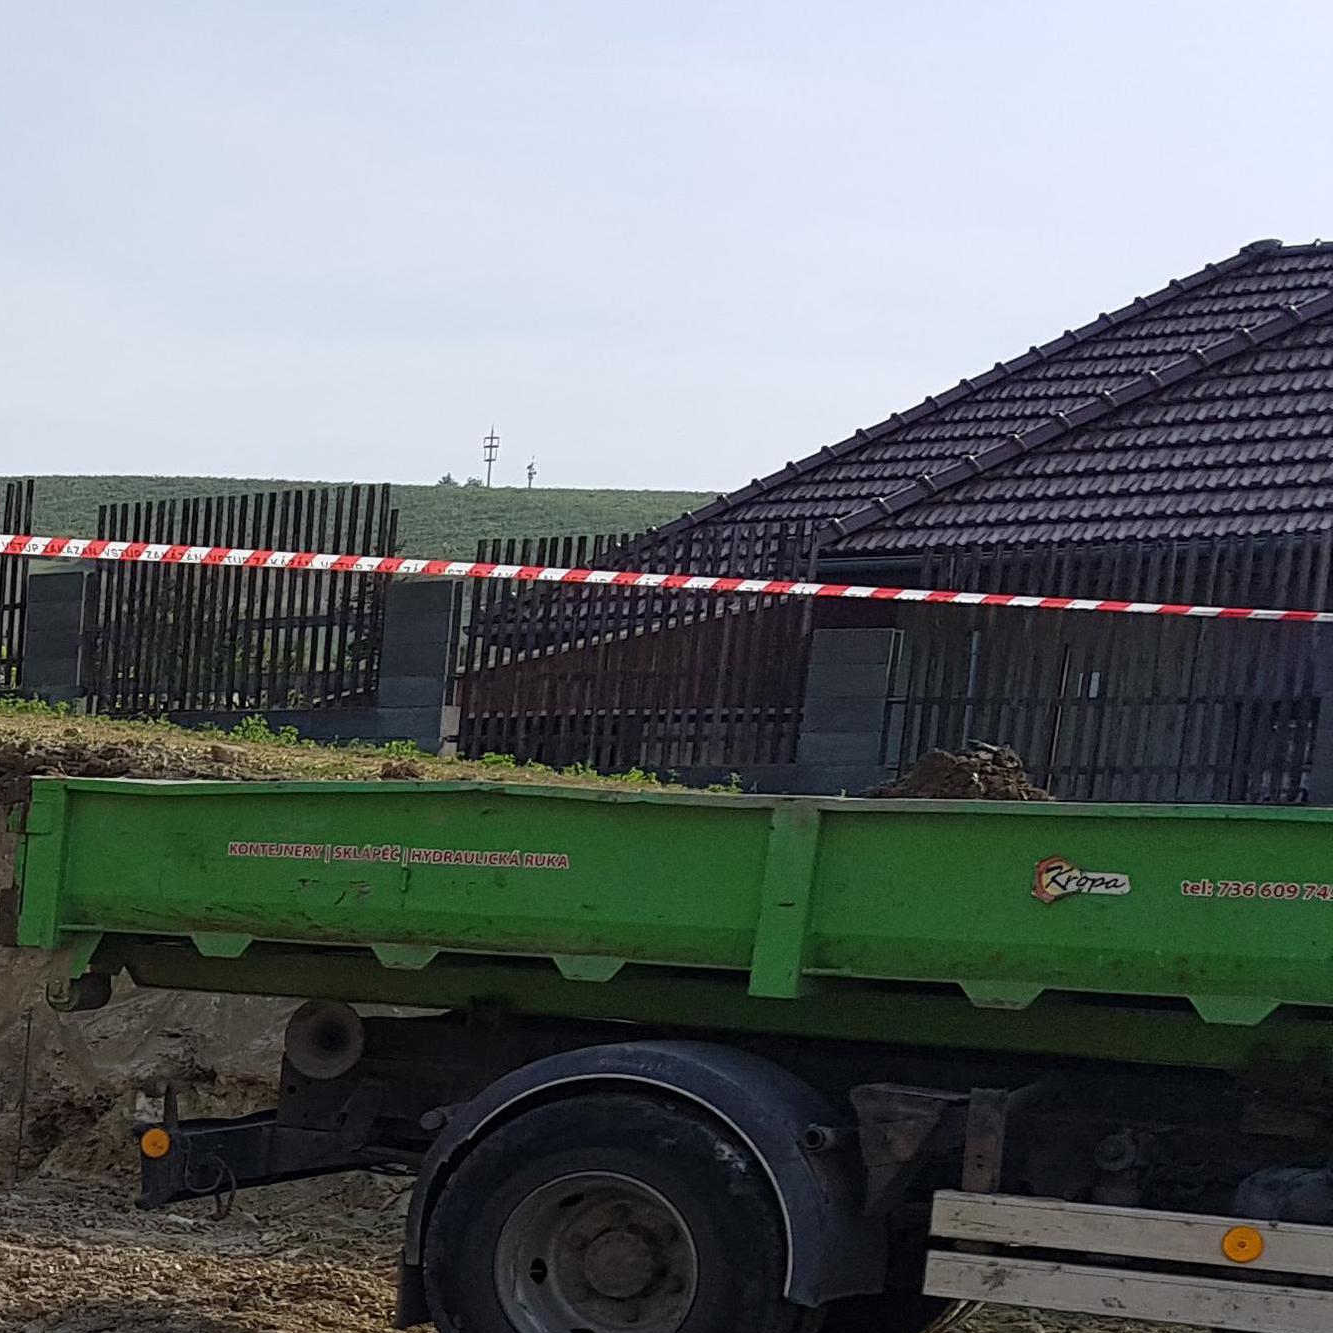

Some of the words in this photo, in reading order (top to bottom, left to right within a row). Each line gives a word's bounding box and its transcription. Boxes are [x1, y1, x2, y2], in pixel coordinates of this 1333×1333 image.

[229, 842, 324, 859] KONTEJNERY
[410, 848, 520, 867] HYDRAULICKÁ
[523, 853, 570, 869] RUKA
[1044, 864, 1126, 892] Kropa
[1181, 879, 1213, 896] tel:
[1217, 881, 1256, 898] 736
[1258, 883, 1300, 899] 609
[1302, 883, 1333, 900] 74
